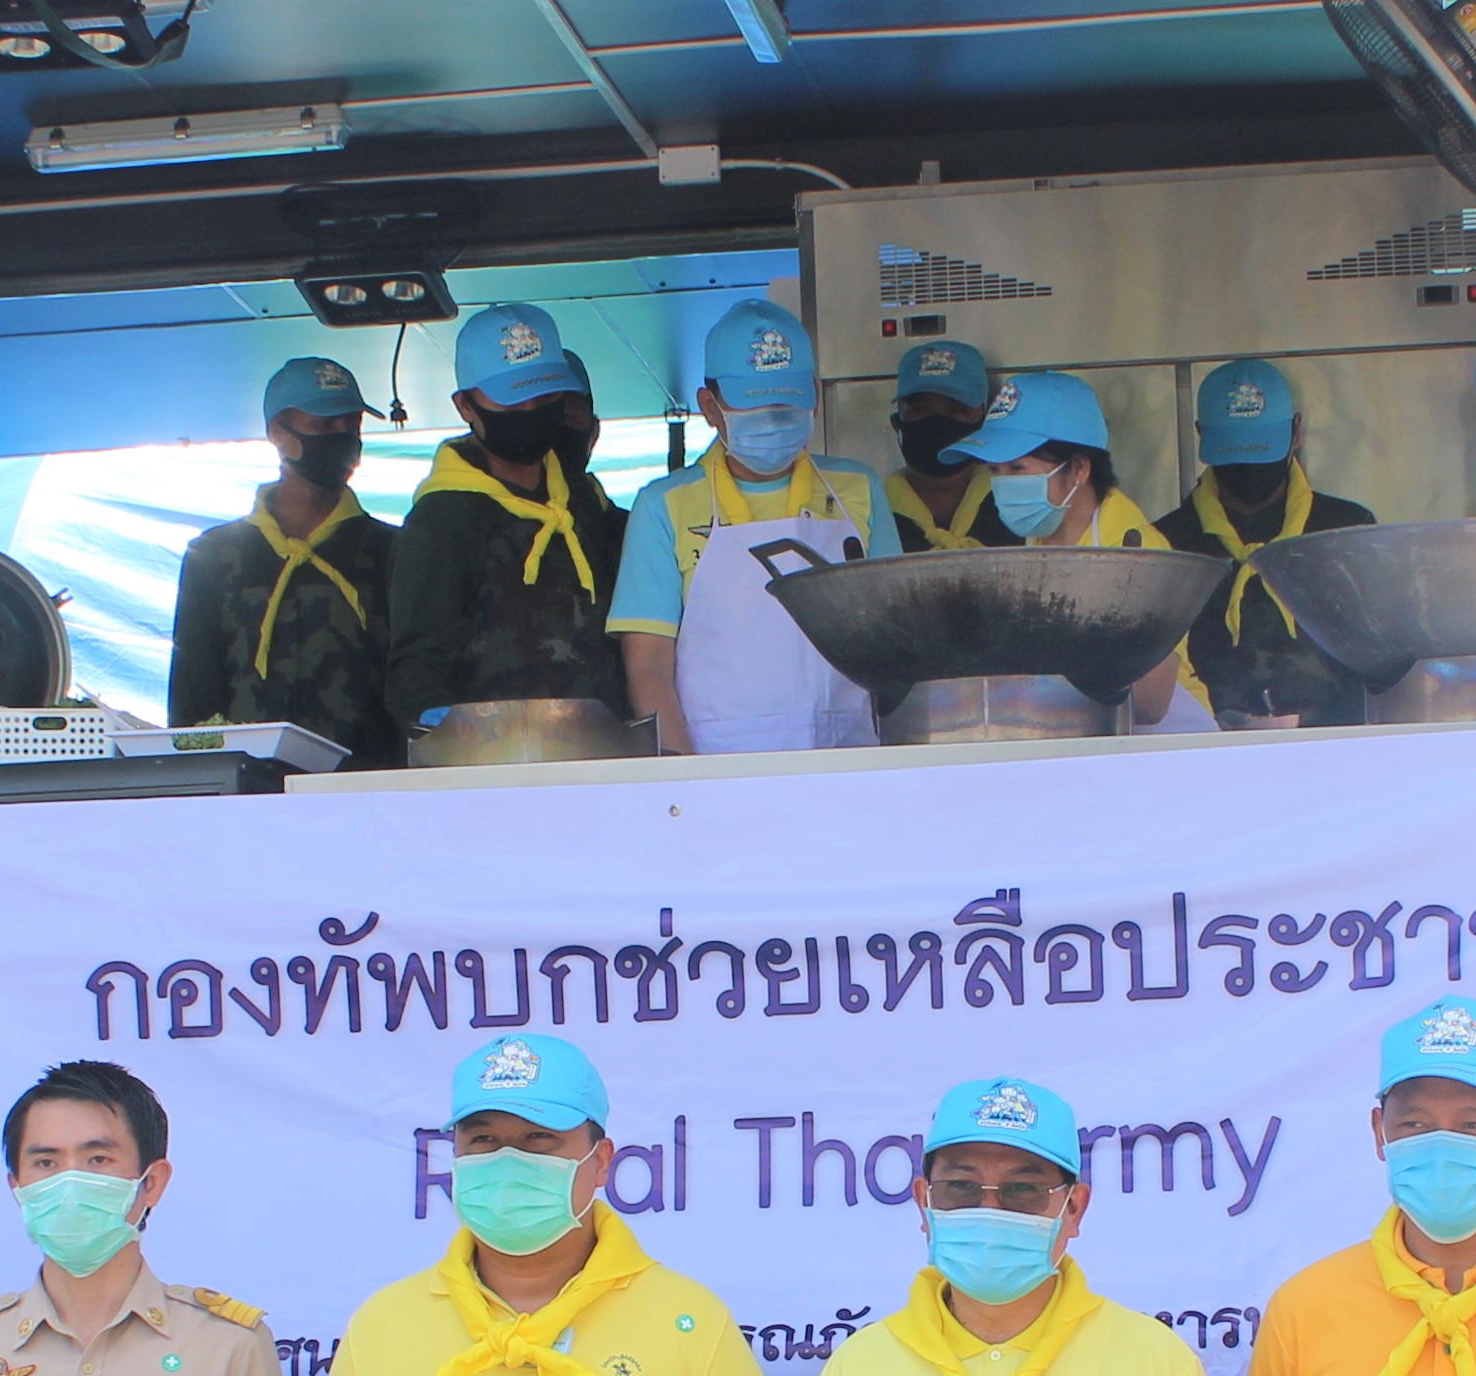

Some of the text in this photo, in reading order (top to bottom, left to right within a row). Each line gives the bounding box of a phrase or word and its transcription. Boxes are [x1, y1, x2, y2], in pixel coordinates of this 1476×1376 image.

[413, 1111, 1282, 1220] Ral Tha rmy
